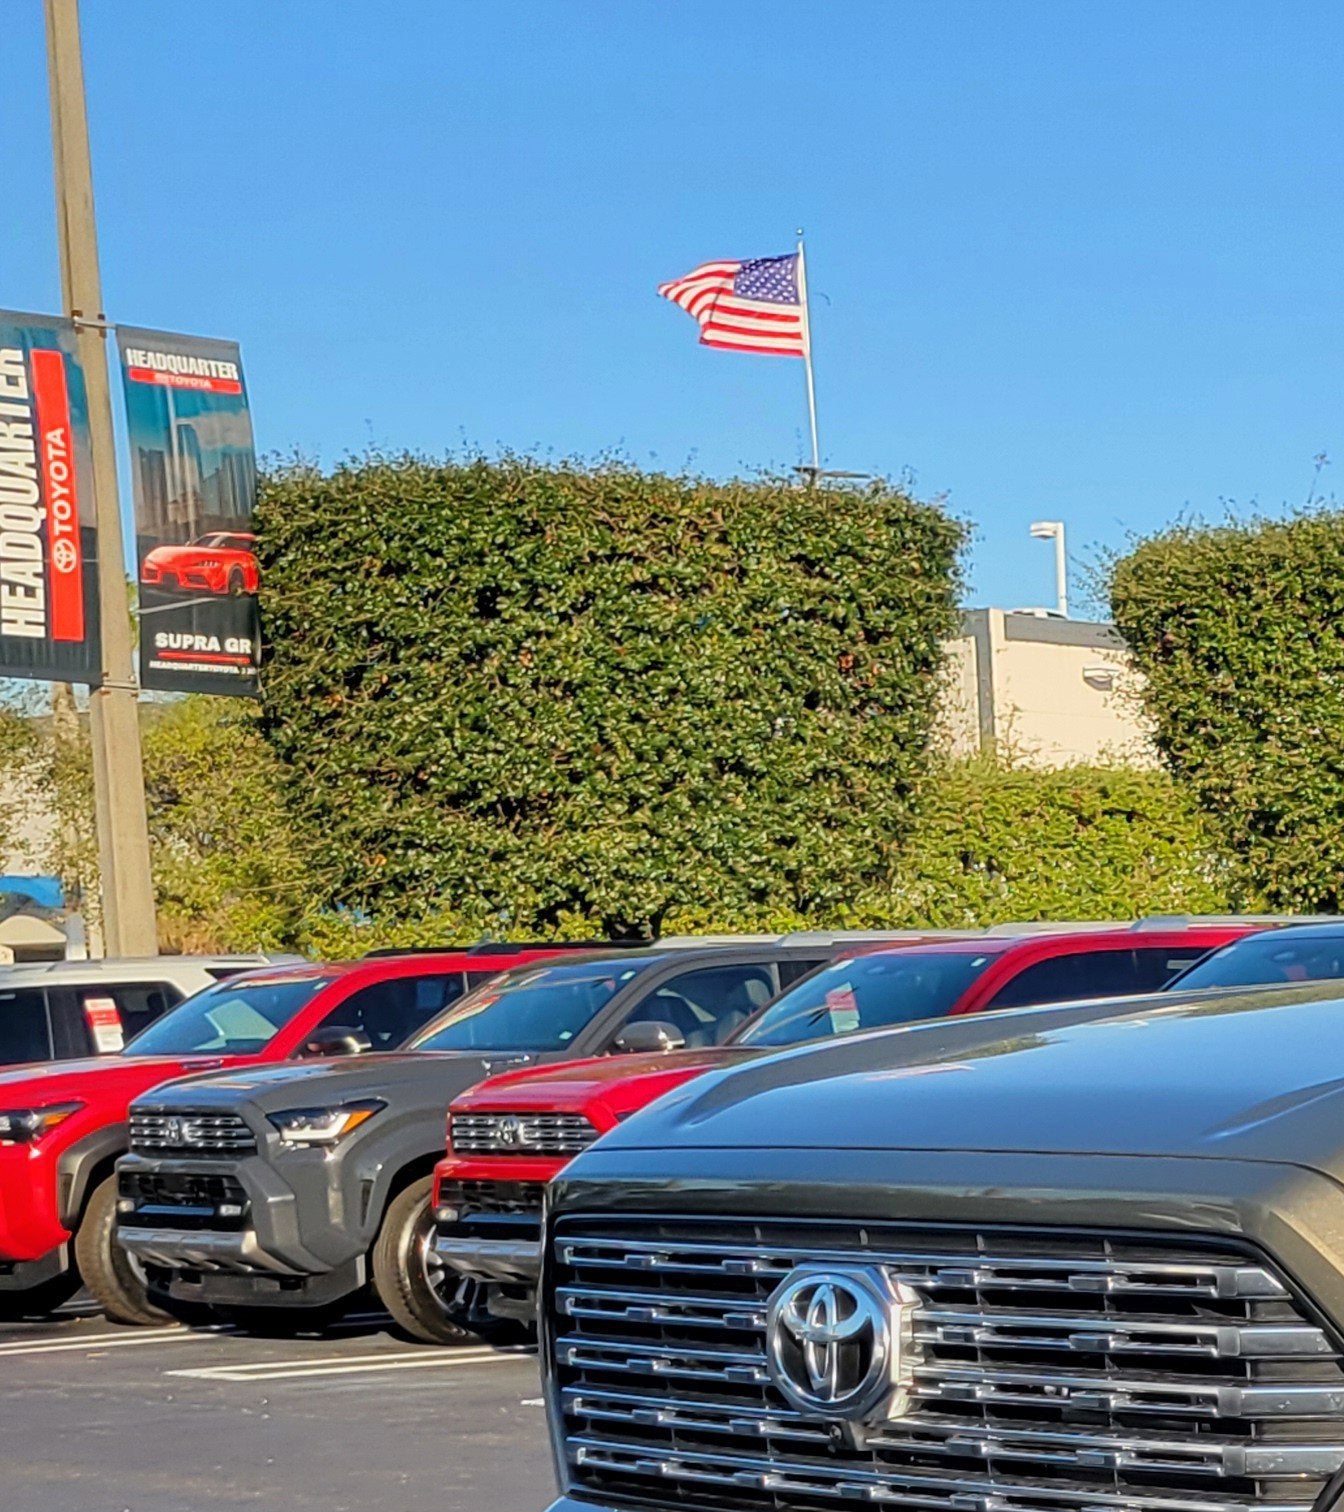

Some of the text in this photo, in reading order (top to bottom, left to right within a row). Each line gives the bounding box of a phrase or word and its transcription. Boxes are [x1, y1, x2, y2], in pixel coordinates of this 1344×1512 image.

[126, 347, 240, 381] HEADQUARTER
[170, 376, 213, 390] TOYOTA
[46, 427, 73, 537] TOYOTA
[155, 631, 252, 654] SUPRA GR
